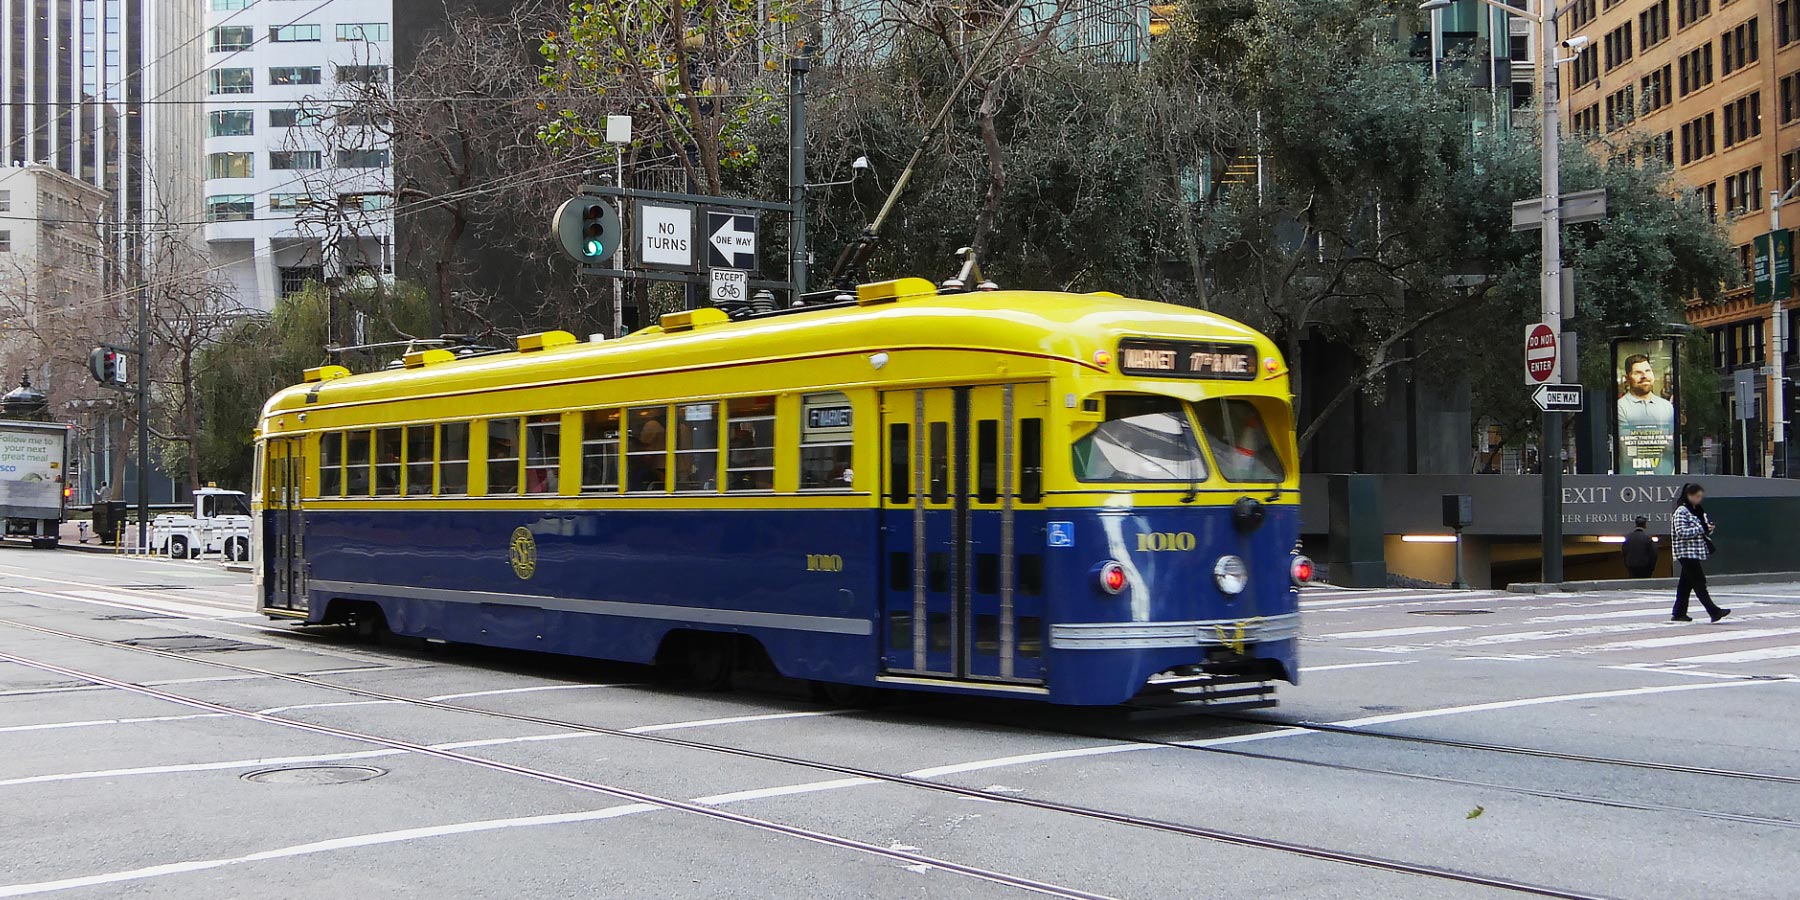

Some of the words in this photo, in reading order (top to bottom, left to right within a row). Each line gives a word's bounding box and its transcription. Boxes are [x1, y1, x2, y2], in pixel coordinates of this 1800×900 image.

[659, 222, 675, 234] NO
[647, 237, 687, 251] TURNS
[716, 235, 732, 245] ONE
[735, 238, 752, 246] WAY
[714, 272, 744, 281] EXCEPT
[1530, 337, 1539, 346] DO
[1541, 334, 1553, 344] NOT
[1123, 349, 1177, 369] MARKET
[1531, 361, 1552, 372] ENTER
[1547, 393, 1561, 402] ONE
[1563, 393, 1577, 402] WAY
[1633, 458, 1660, 468] DAV
[1562, 487, 1611, 503] EXIT
[1620, 486, 1680, 503] ONLY
[1562, 513, 1581, 523] TER
[1586, 513, 1617, 523] FROM
[1136, 532, 1196, 552] 1010
[807, 554, 843, 571] 1010
